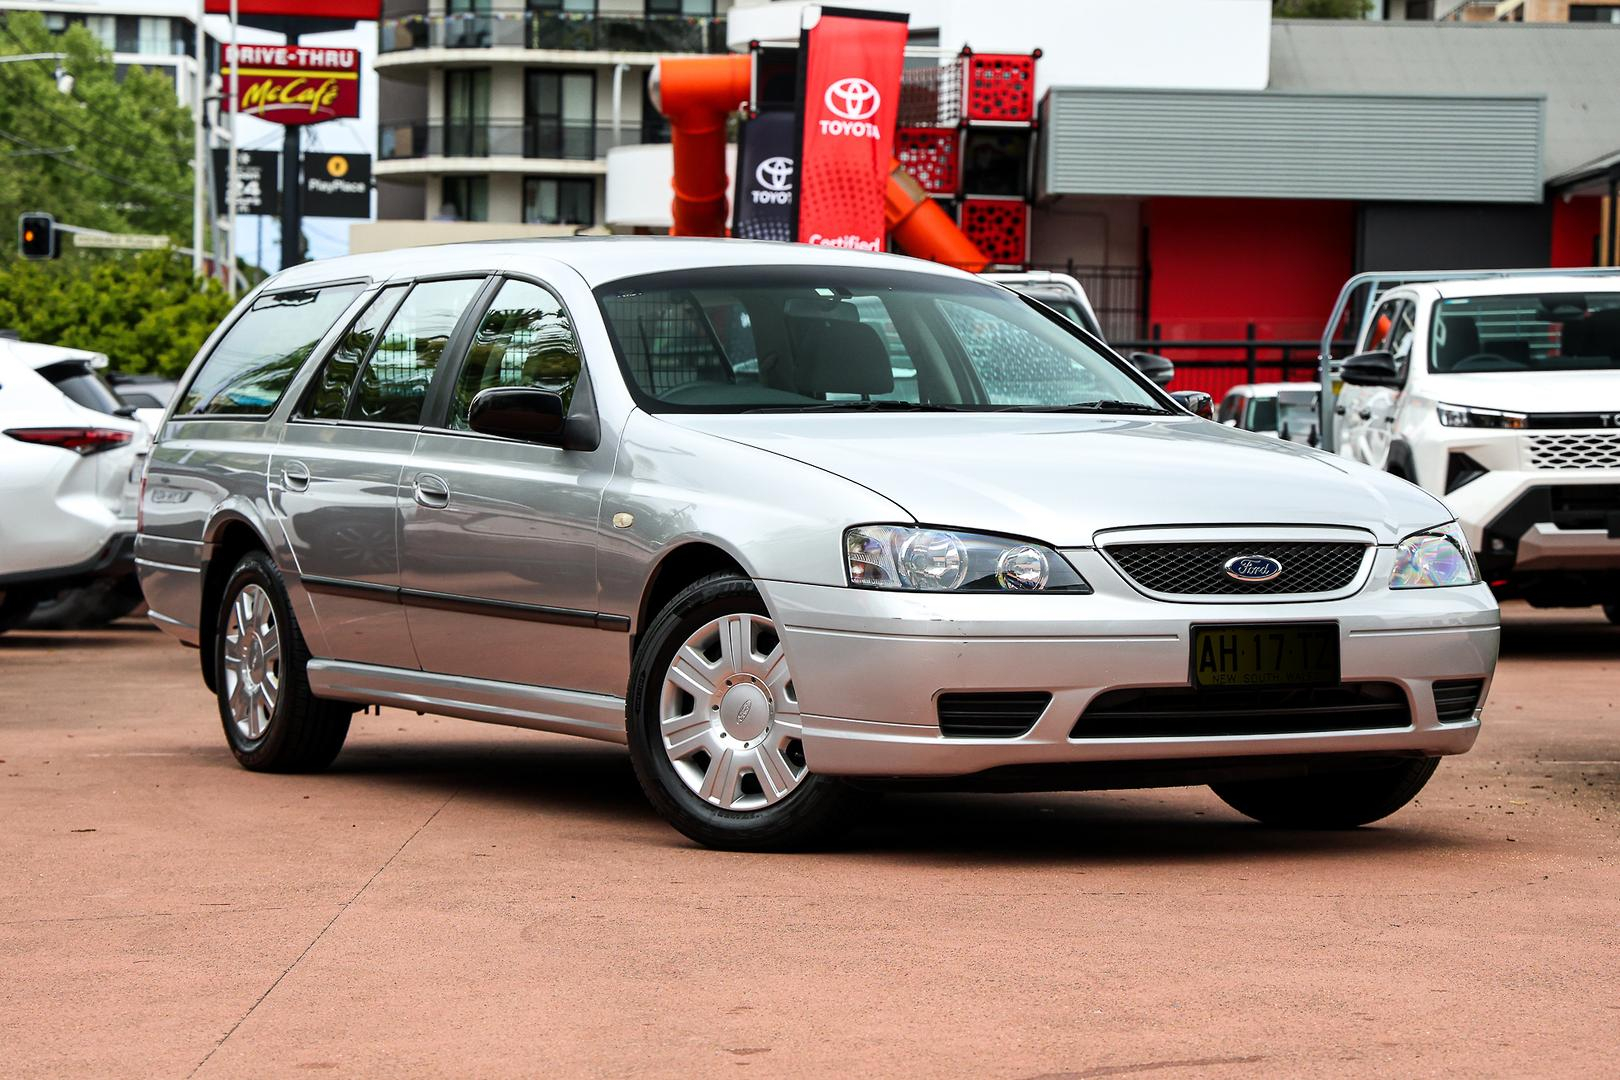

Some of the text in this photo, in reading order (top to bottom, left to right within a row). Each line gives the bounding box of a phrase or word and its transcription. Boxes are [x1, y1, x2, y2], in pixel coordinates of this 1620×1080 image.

[818, 120, 881, 140] TOYOTA
[308, 178, 366, 194] PlayPlace
[808, 233, 881, 252] Certified
[1238, 559, 1270, 575] Ford
